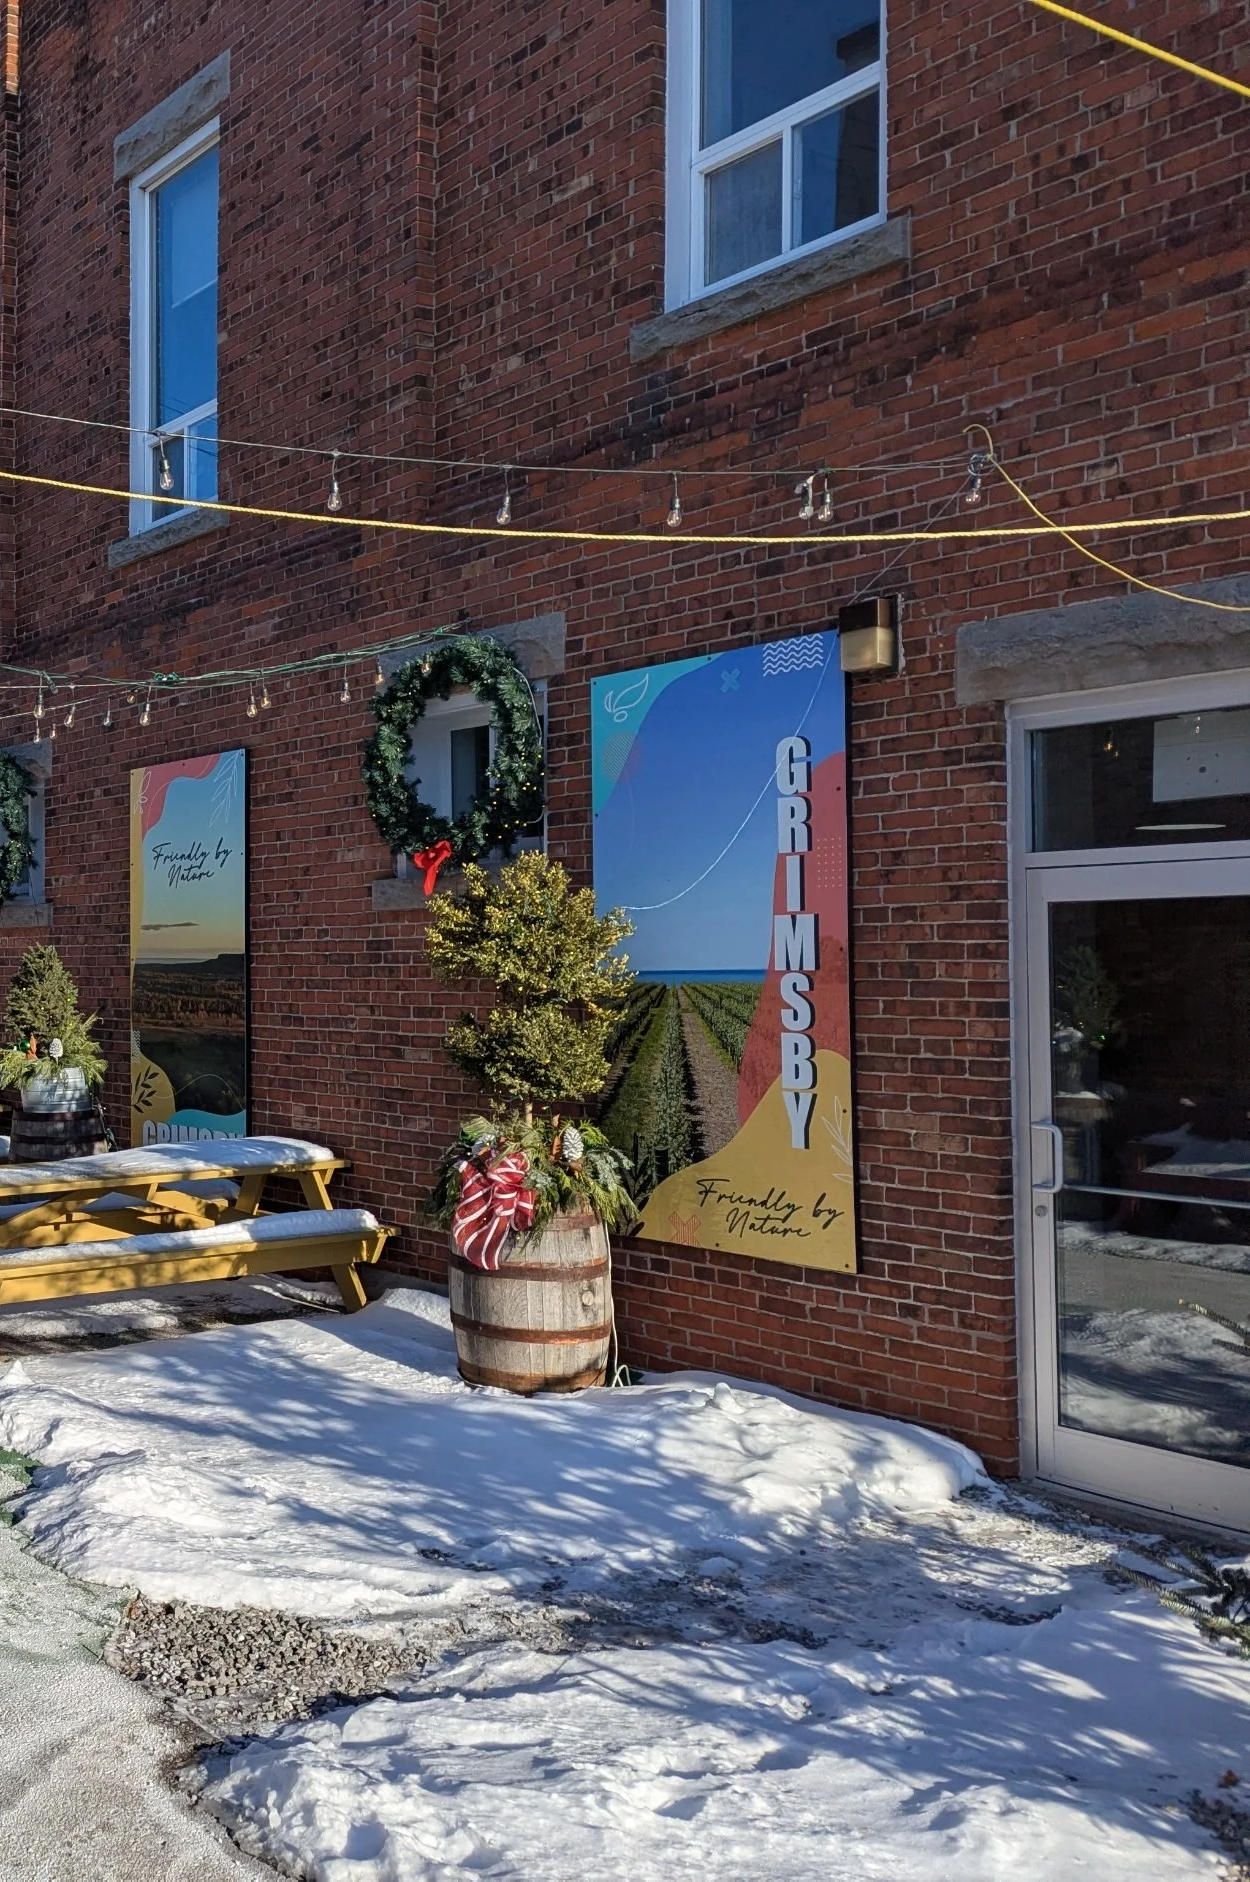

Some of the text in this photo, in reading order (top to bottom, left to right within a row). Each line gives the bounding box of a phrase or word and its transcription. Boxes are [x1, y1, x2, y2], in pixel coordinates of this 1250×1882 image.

[152, 836, 233, 870] Friendly by
[168, 864, 214, 889] Nature
[773, 736, 818, 1150] GRIMSBY
[696, 1178, 845, 1230] Friendly by
[725, 1207, 811, 1238] Nature
